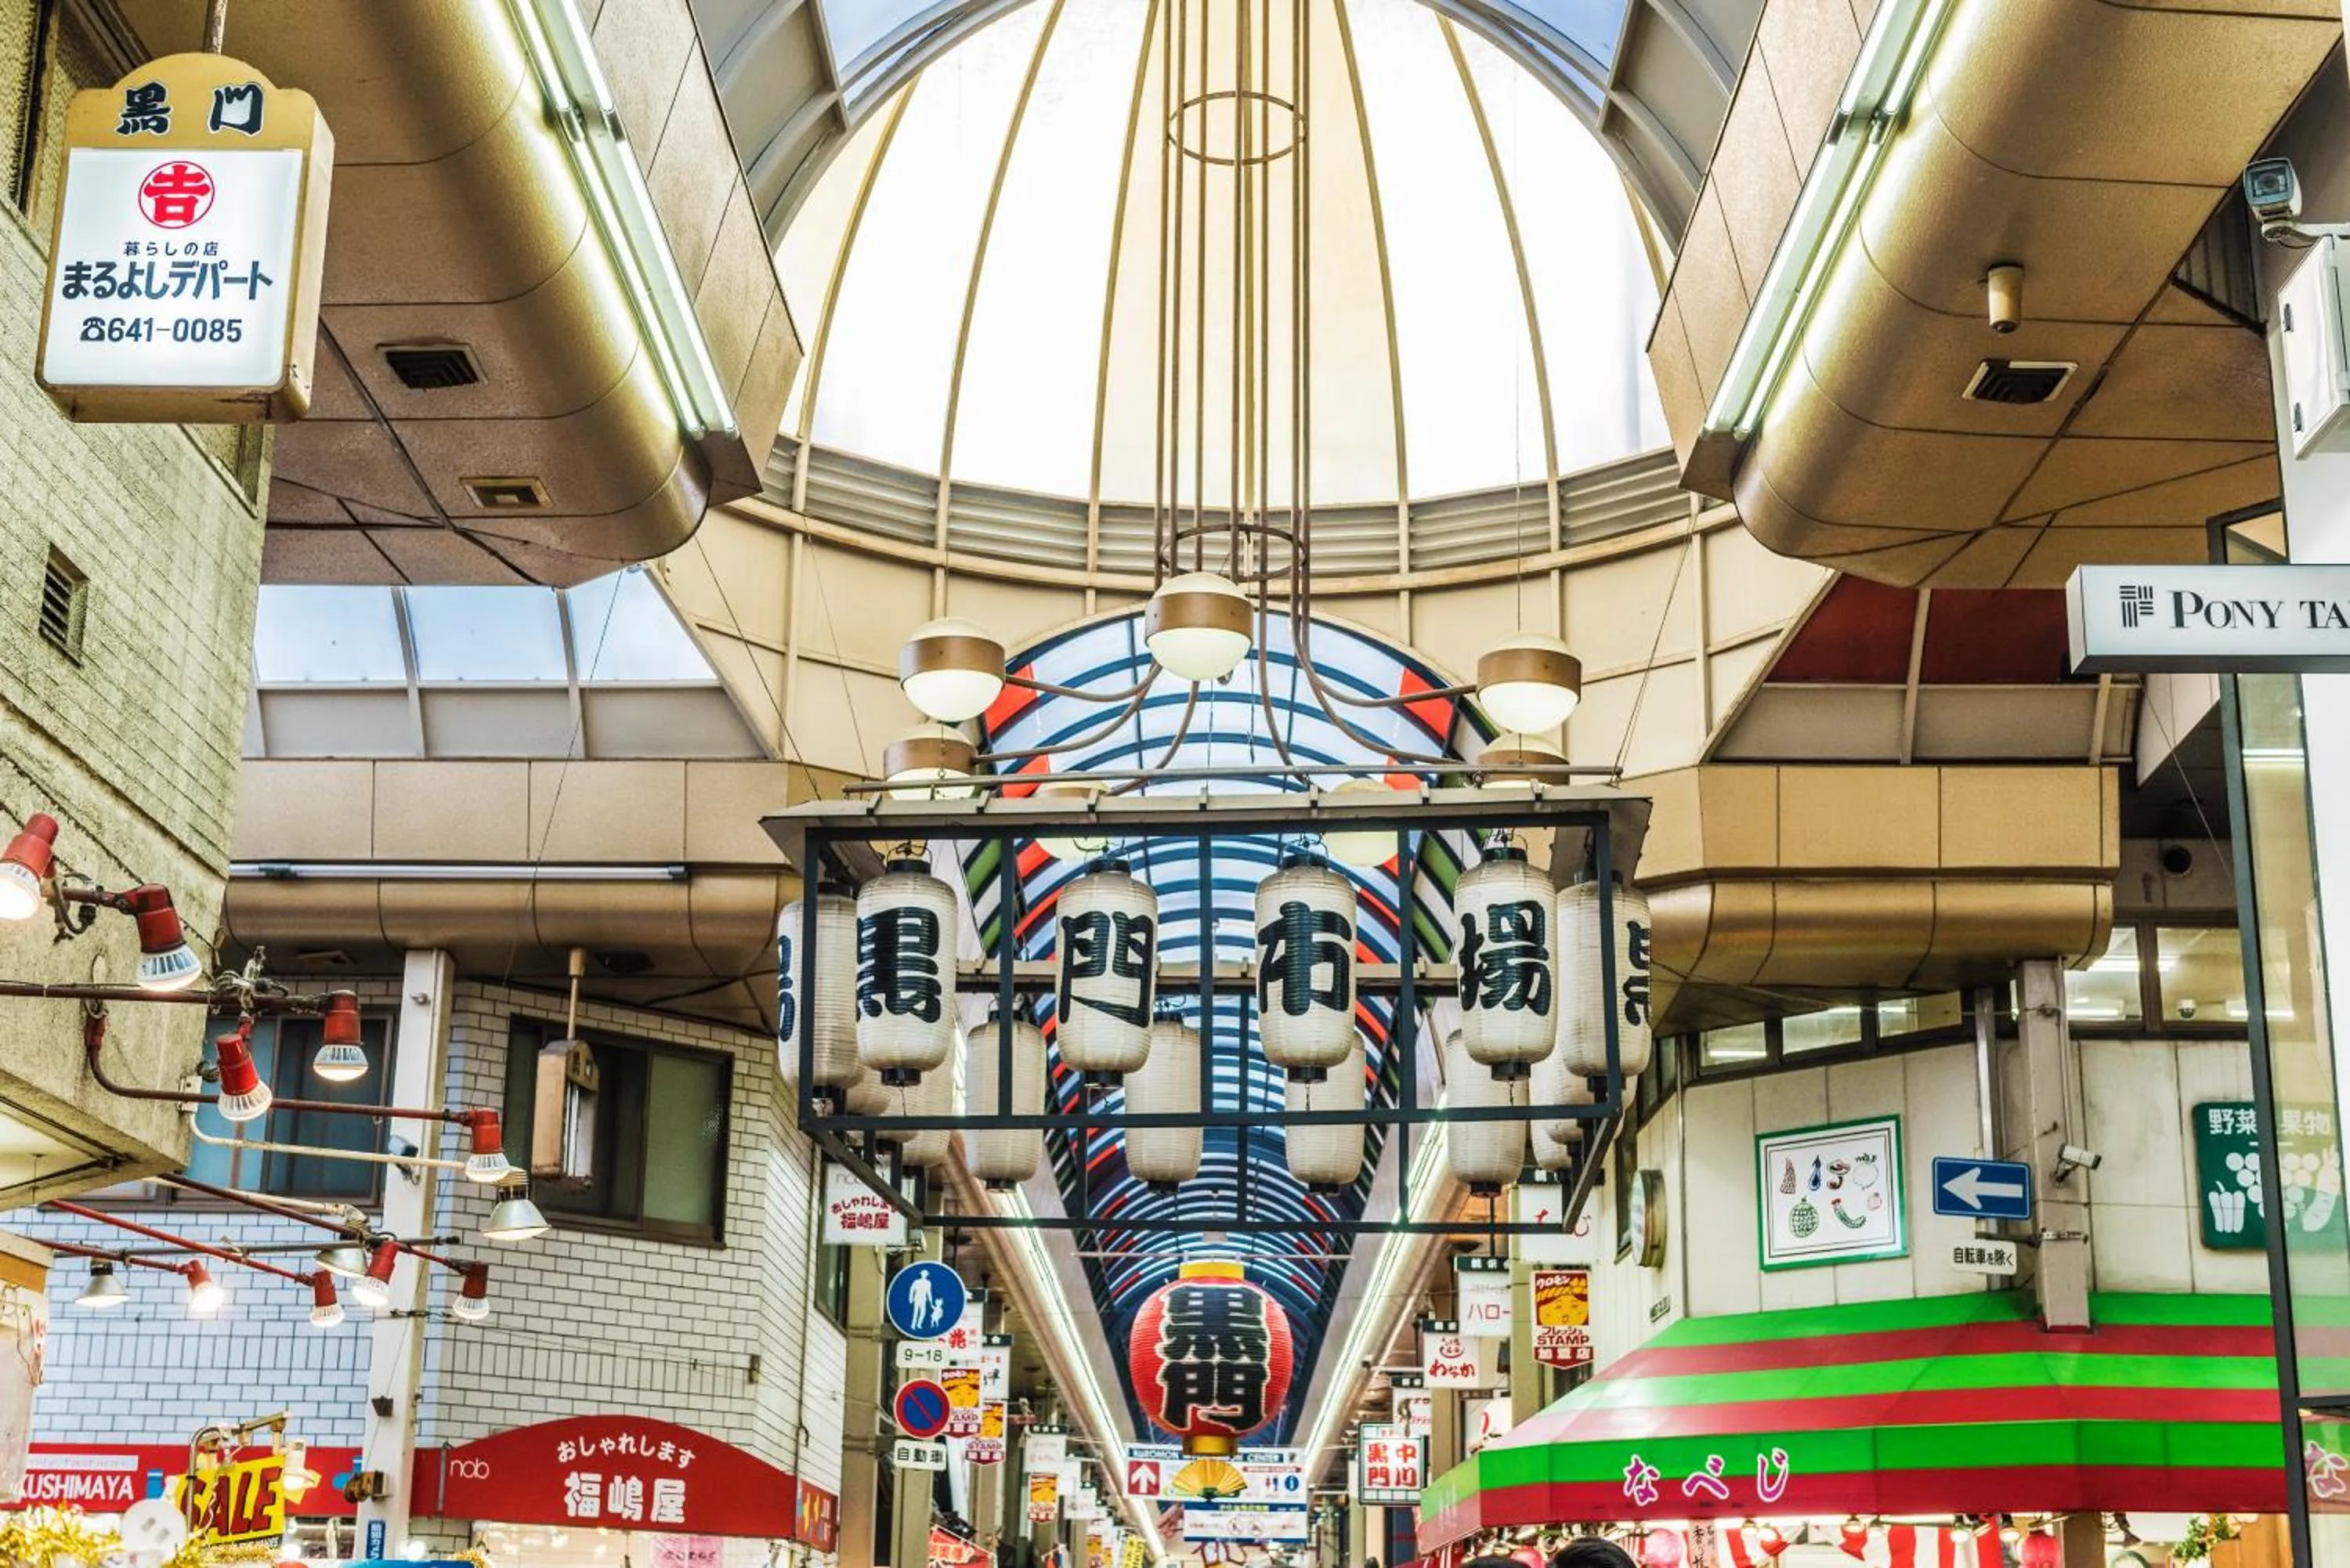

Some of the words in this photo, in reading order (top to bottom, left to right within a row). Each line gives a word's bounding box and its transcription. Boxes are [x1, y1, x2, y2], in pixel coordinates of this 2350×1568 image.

[117, 81, 266, 136] 黒門
[124, 241, 219, 256] 暮らしの店
[62, 259, 273, 301] まるよしデパート
[107, 318, 243, 342] 641-0085
[2168, 590, 2285, 629] PONY
[2299, 600, 2350, 629] TA
[1257, 901, 1352, 1017] 市
[1458, 900, 1551, 1017] 場
[1954, 1247, 2013, 1266] 自転車を除く
[904, 1348, 943, 1362] 9-18
[1538, 1335, 1590, 1346] STAMP
[557, 1433, 695, 1469] おしゃれします
[1623, 1447, 1790, 1506] なべじ
[180, 1465, 284, 1537] SALE
[564, 1471, 687, 1523] 福嶋屋
